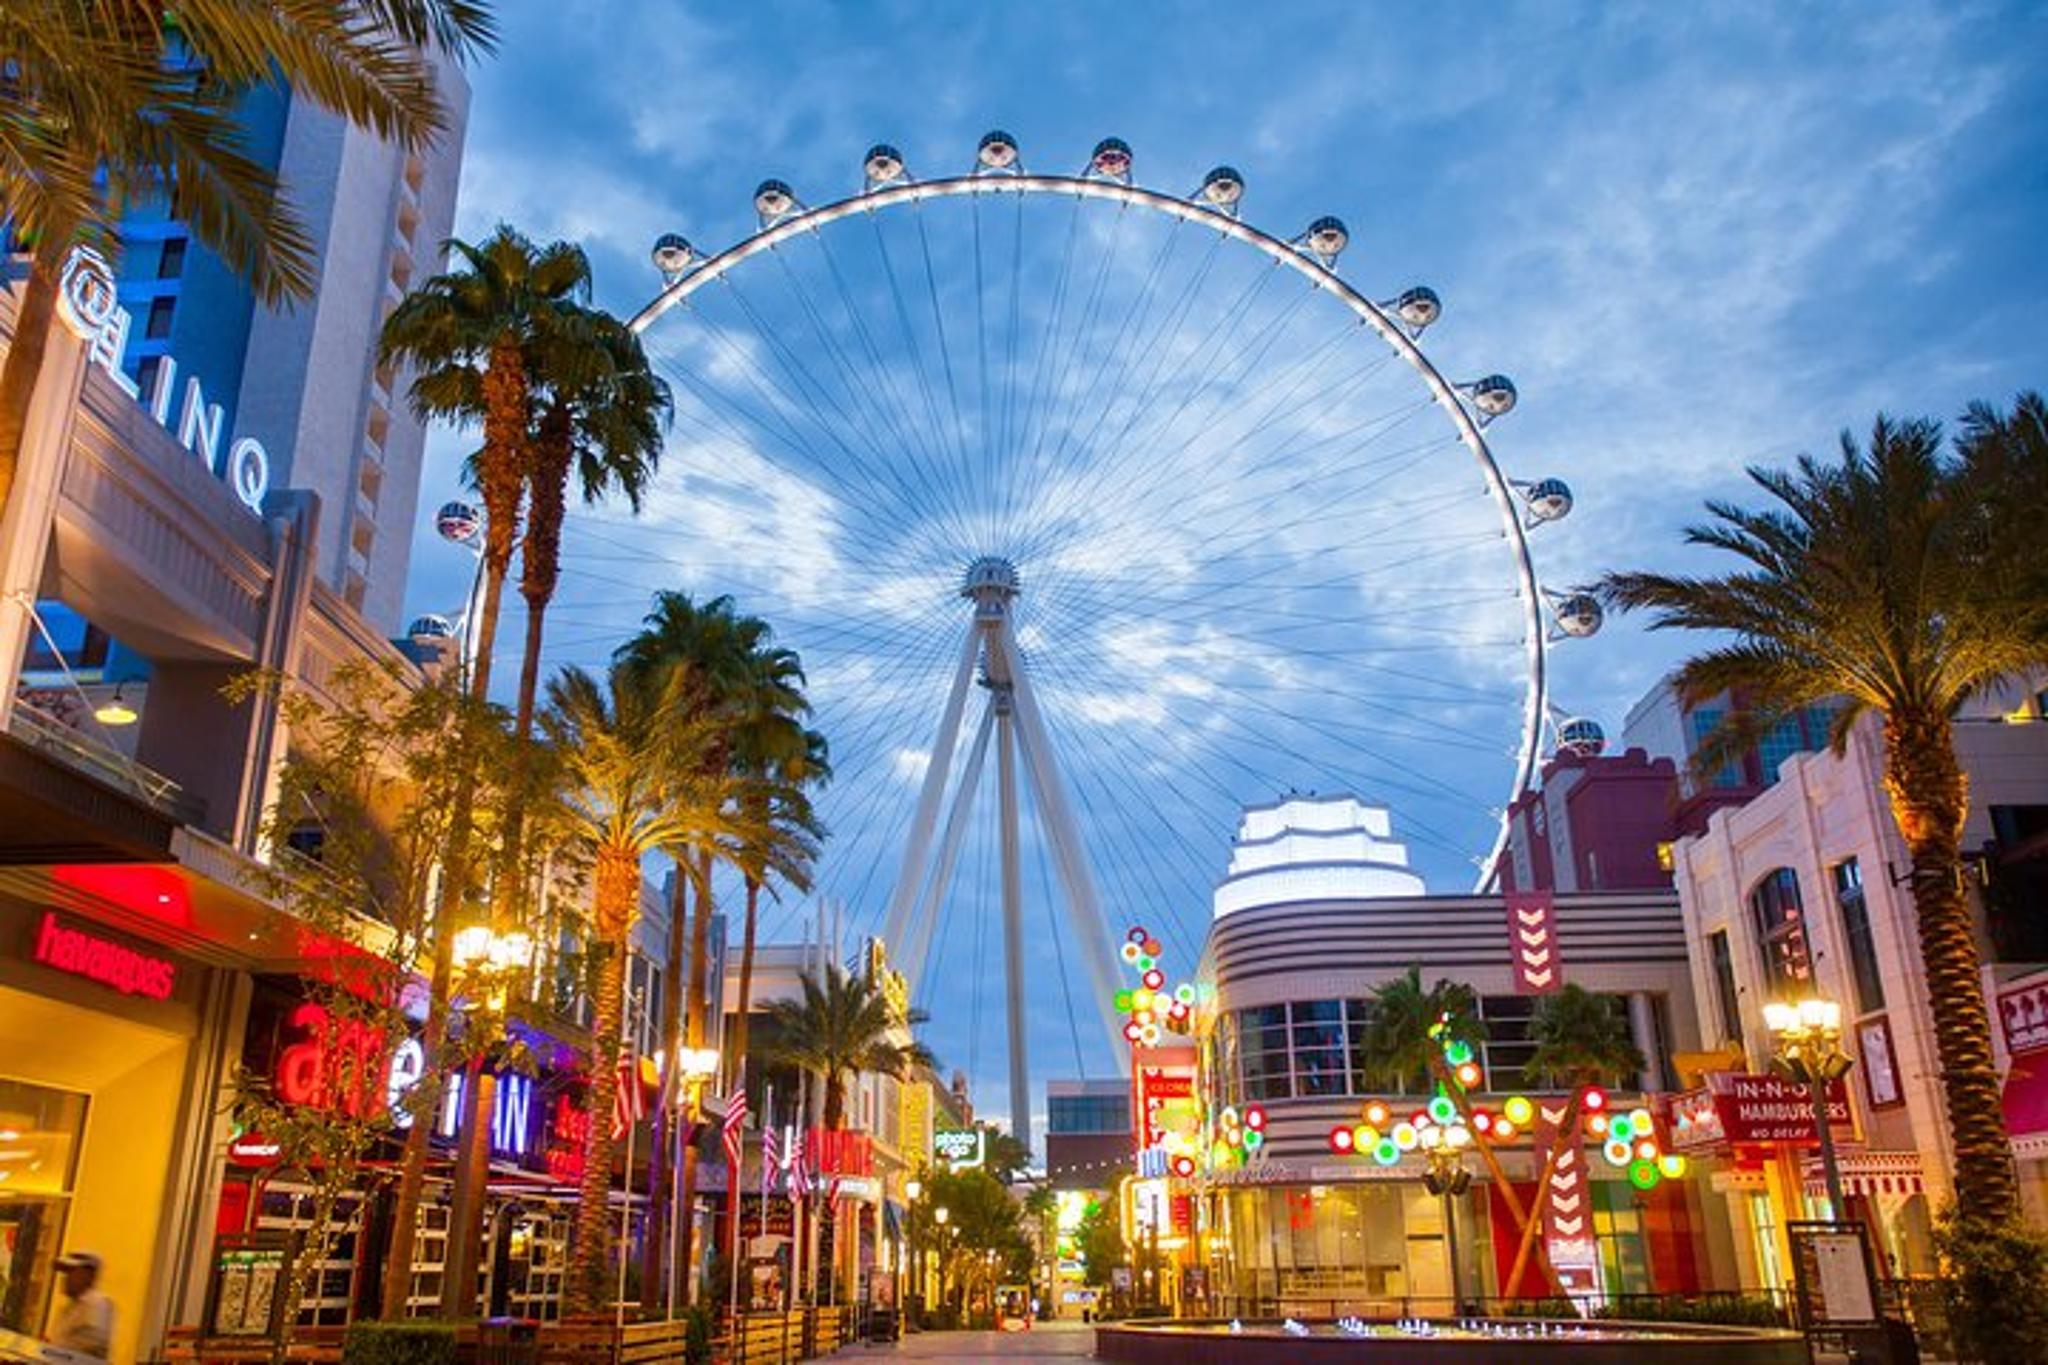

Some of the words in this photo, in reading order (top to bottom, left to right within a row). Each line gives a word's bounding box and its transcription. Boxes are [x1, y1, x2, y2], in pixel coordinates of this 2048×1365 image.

[106, 306, 268, 516] LINQ
[1735, 1080, 1833, 1098] IN-N-OT
[1751, 1127, 1770, 1139] NO
[1772, 1126, 1810, 1139] DELAY
